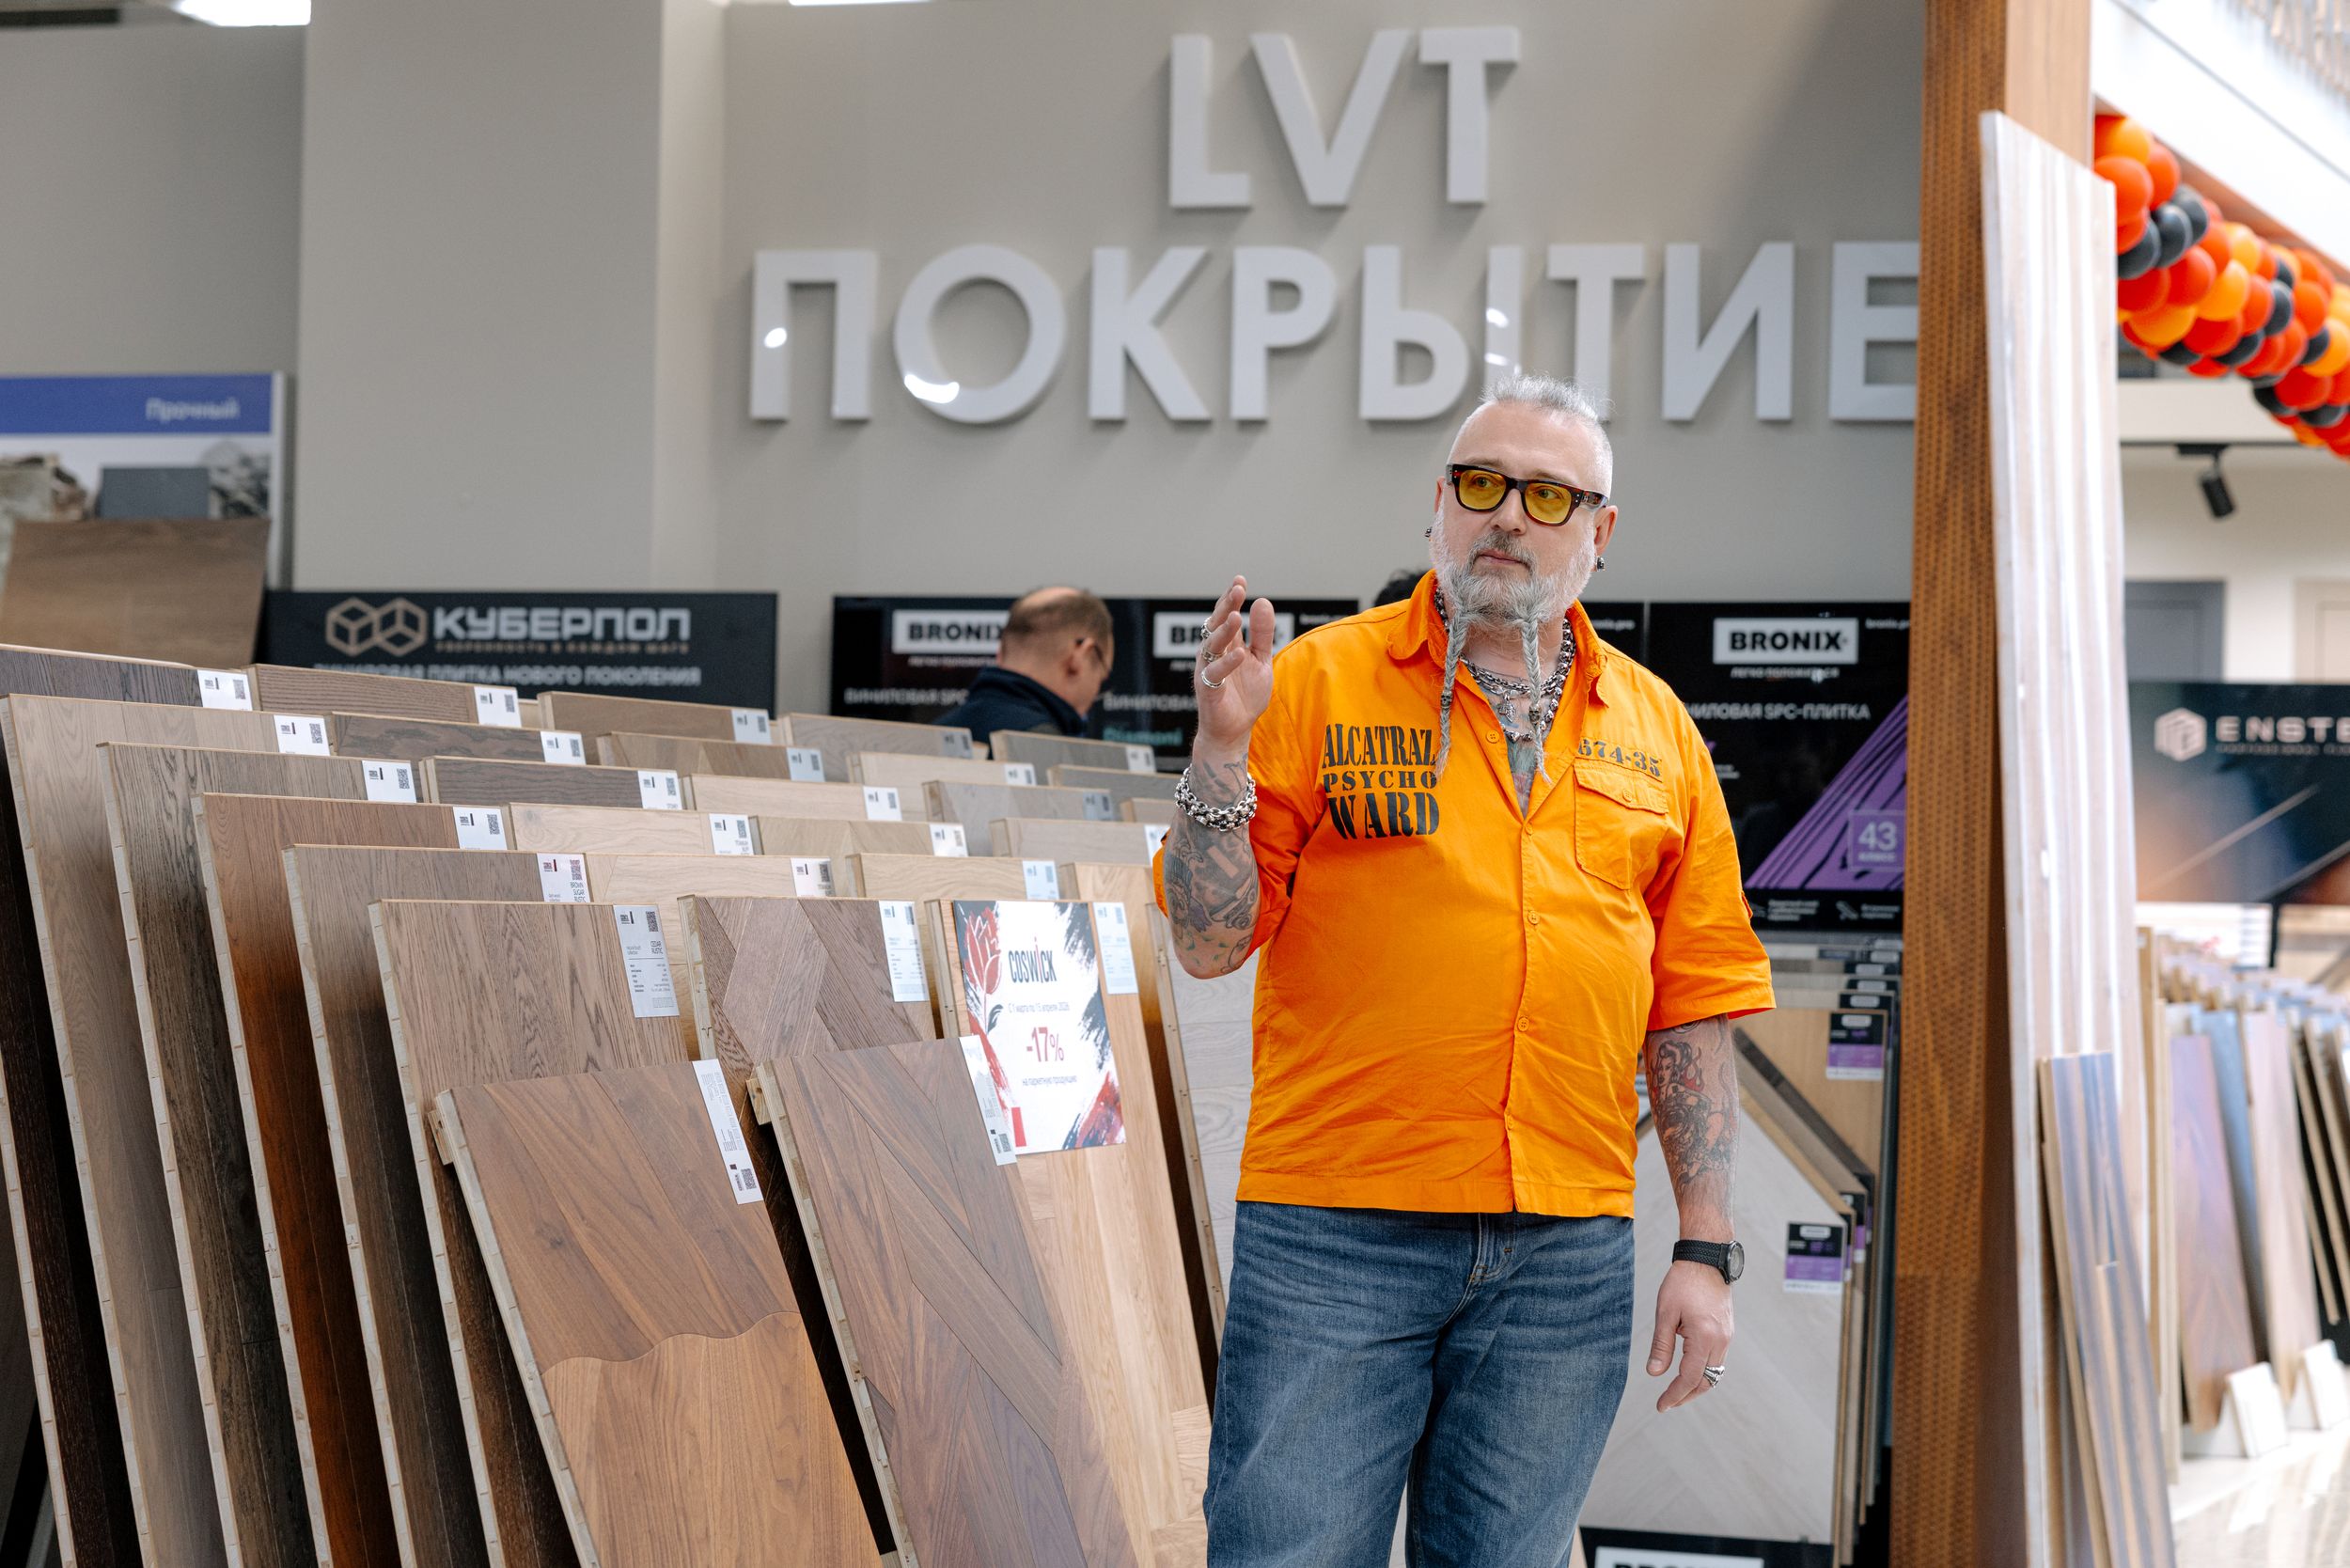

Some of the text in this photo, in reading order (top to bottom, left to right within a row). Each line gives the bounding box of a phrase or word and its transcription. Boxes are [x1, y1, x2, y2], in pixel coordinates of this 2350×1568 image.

[1168, 26, 1521, 208] LVT
[751, 241, 1919, 423] ПОКРЫТИЕ
[434, 607, 691, 641] КУБЕРПОЛ
[1731, 632, 1842, 651] BRONIX
[502, 665, 583, 685] НОВОГО
[584, 666, 701, 686] ПОКОЛЕНИЯ
[1763, 703, 1871, 721] SPC-ПЛИТКА
[1322, 724, 1436, 769] ALCATRAZ
[1324, 771, 1437, 793] PSYCHO
[1328, 792, 1440, 840] WARD
[1858, 822, 1897, 851] 43
[1026, 1027, 1064, 1062] -17%
